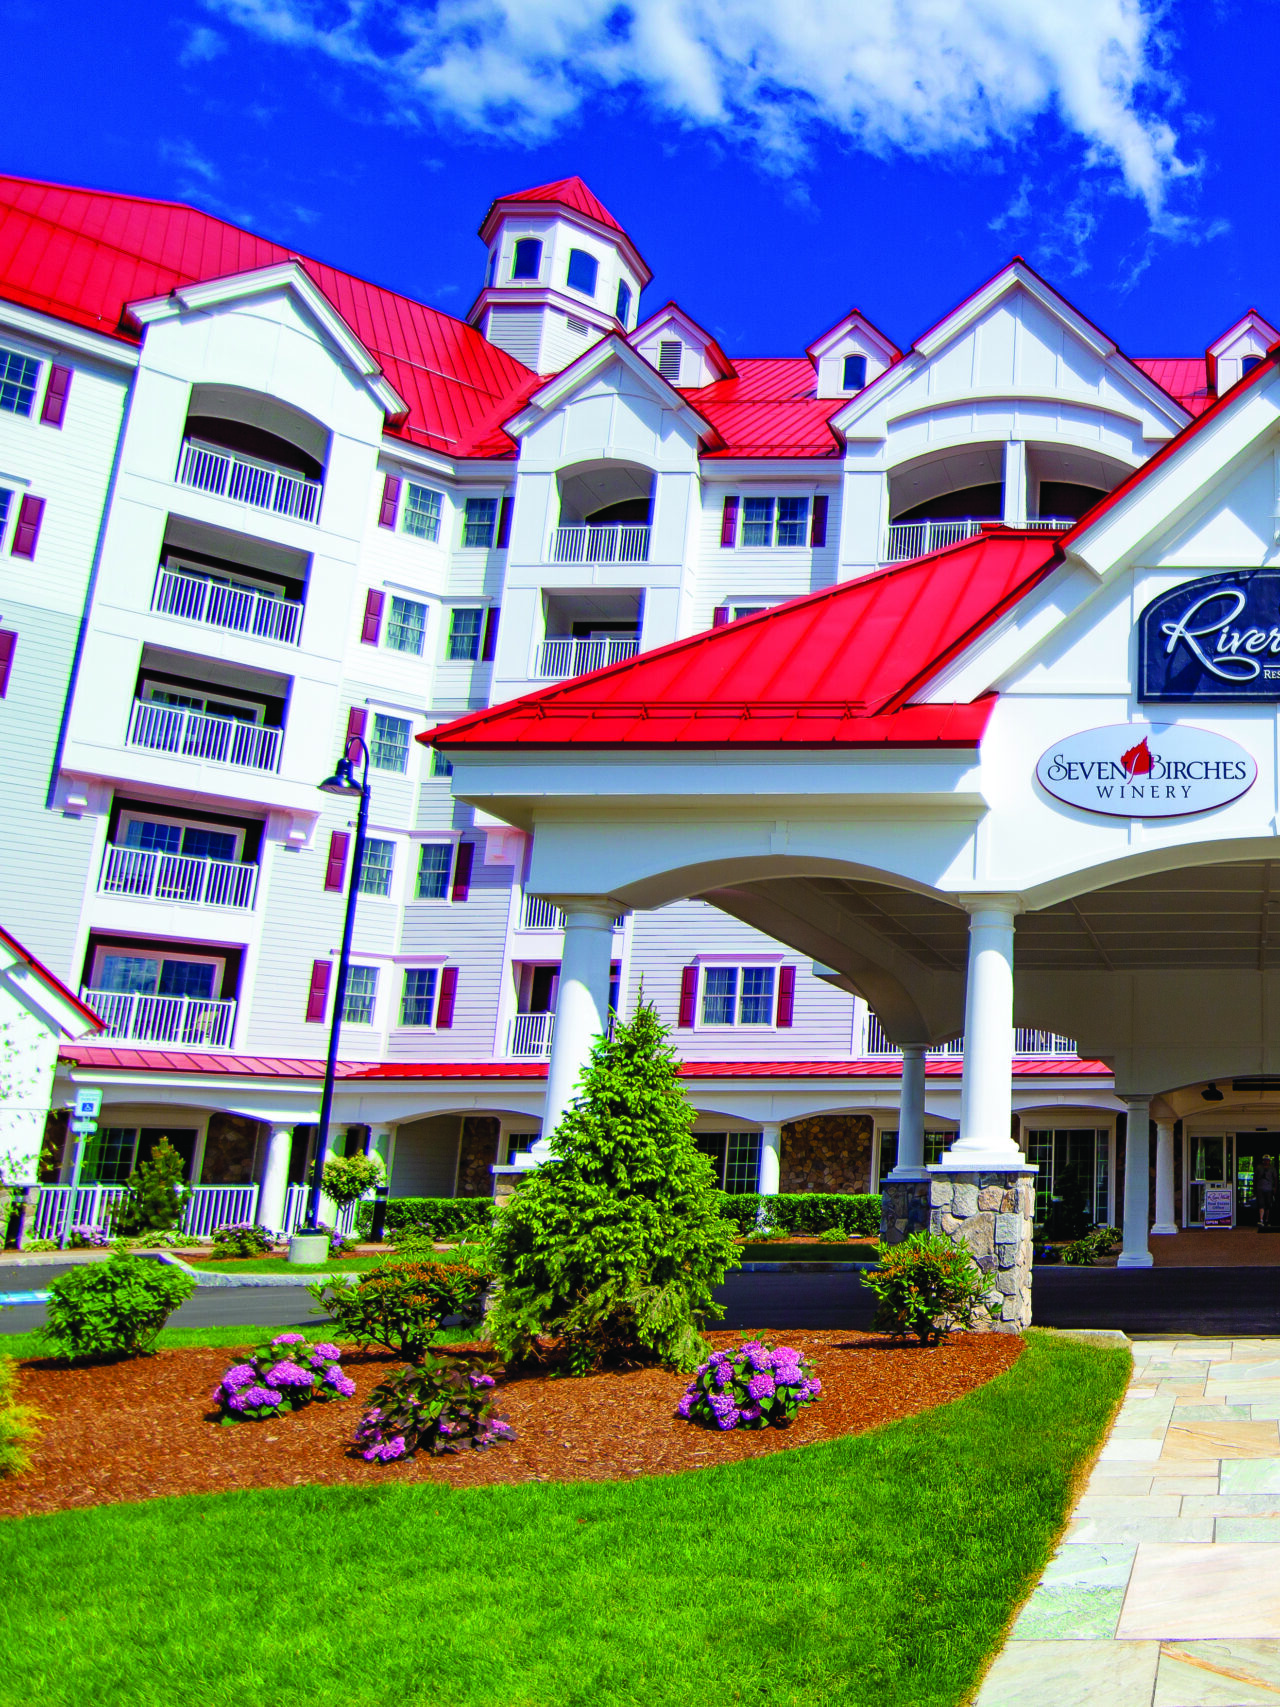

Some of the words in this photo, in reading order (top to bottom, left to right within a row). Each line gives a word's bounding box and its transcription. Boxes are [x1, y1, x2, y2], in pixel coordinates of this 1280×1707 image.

[1047, 754, 1128, 781] SEVEN
[1147, 754, 1247, 780] BIRCHES
[1096, 785, 1192, 799] WINERY
